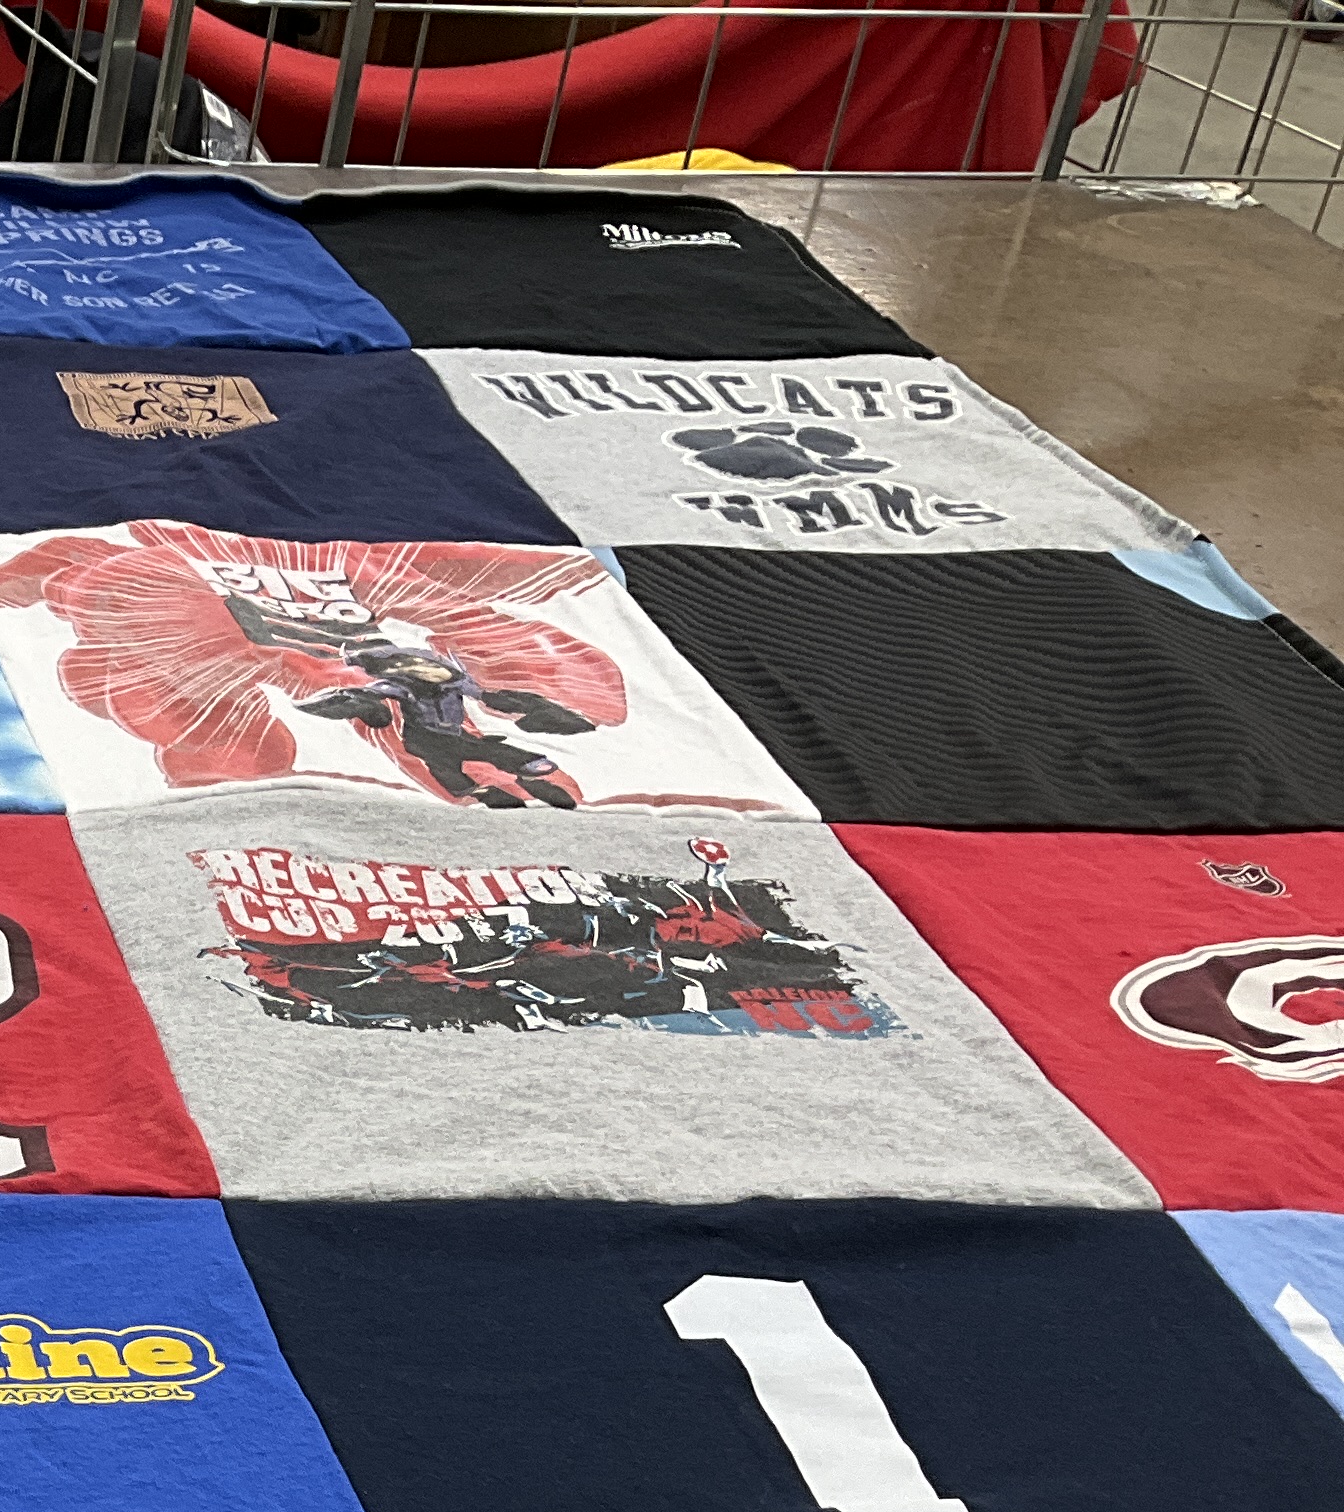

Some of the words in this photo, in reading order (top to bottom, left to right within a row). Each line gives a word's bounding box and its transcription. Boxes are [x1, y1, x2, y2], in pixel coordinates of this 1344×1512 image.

[62, 269, 120, 285] NC
[62, 294, 129, 309] SON
[472, 369, 963, 422] WILDCATS
[188, 557, 358, 602] BIG
[204, 848, 612, 908] RECREATION
[221, 881, 358, 942] CUP
[739, 1000, 875, 1032] NC
[67, 1387, 192, 1401] SCHOOL
